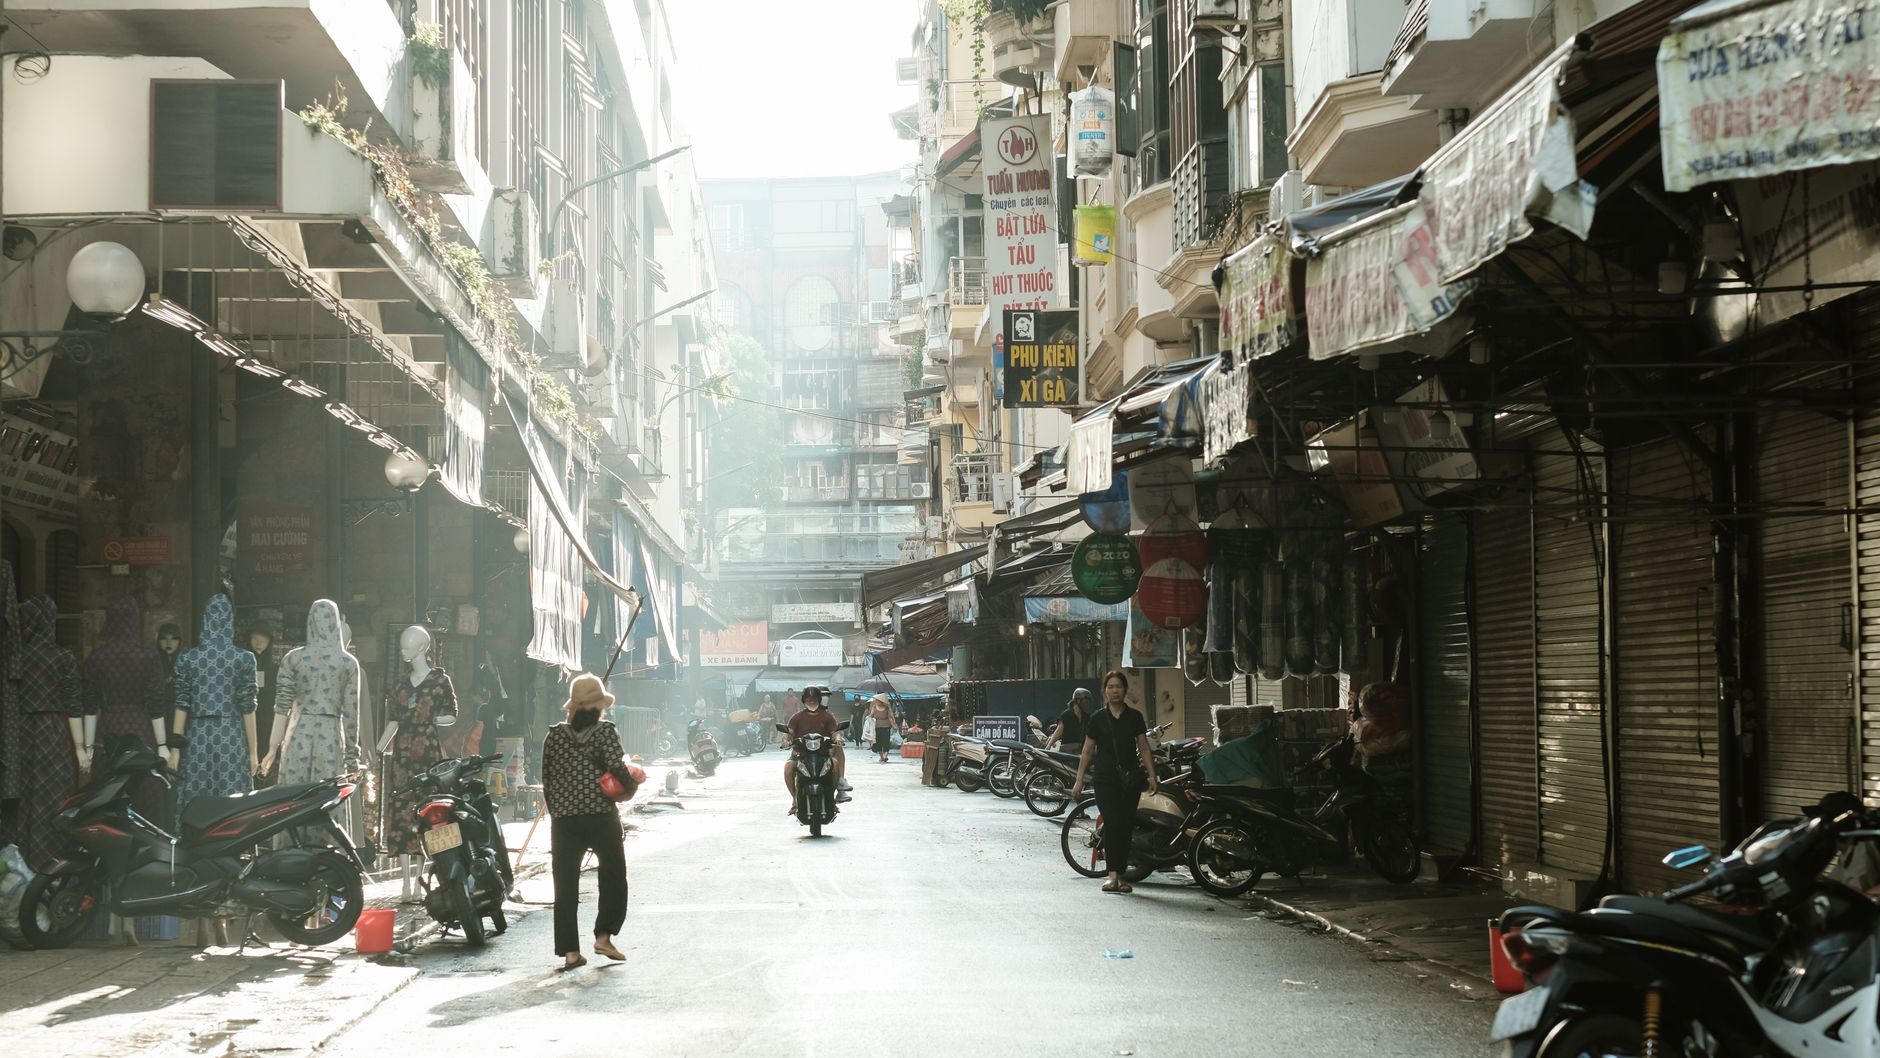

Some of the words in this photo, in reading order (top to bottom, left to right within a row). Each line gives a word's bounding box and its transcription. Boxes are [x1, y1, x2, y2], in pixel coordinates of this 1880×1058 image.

[1002, 140, 1010, 154] T
[1024, 137, 1034, 151] H
[1020, 195, 1034, 207] các
[1035, 195, 1049, 207] loại
[997, 213, 1020, 240] BẬT
[1023, 207, 1047, 235] LỬA
[1008, 236, 1035, 266] TẨU
[992, 271, 1013, 295] HÚT
[1017, 266, 1053, 293] THUỐC
[1010, 345, 1039, 372] PHỤ
[1043, 340, 1076, 372] KIỆN
[1020, 375, 1038, 402] XÌ
[1042, 375, 1067, 402] GÀ
[976, 724, 992, 739] CẤM
[1002, 726, 1016, 739] RÁC
